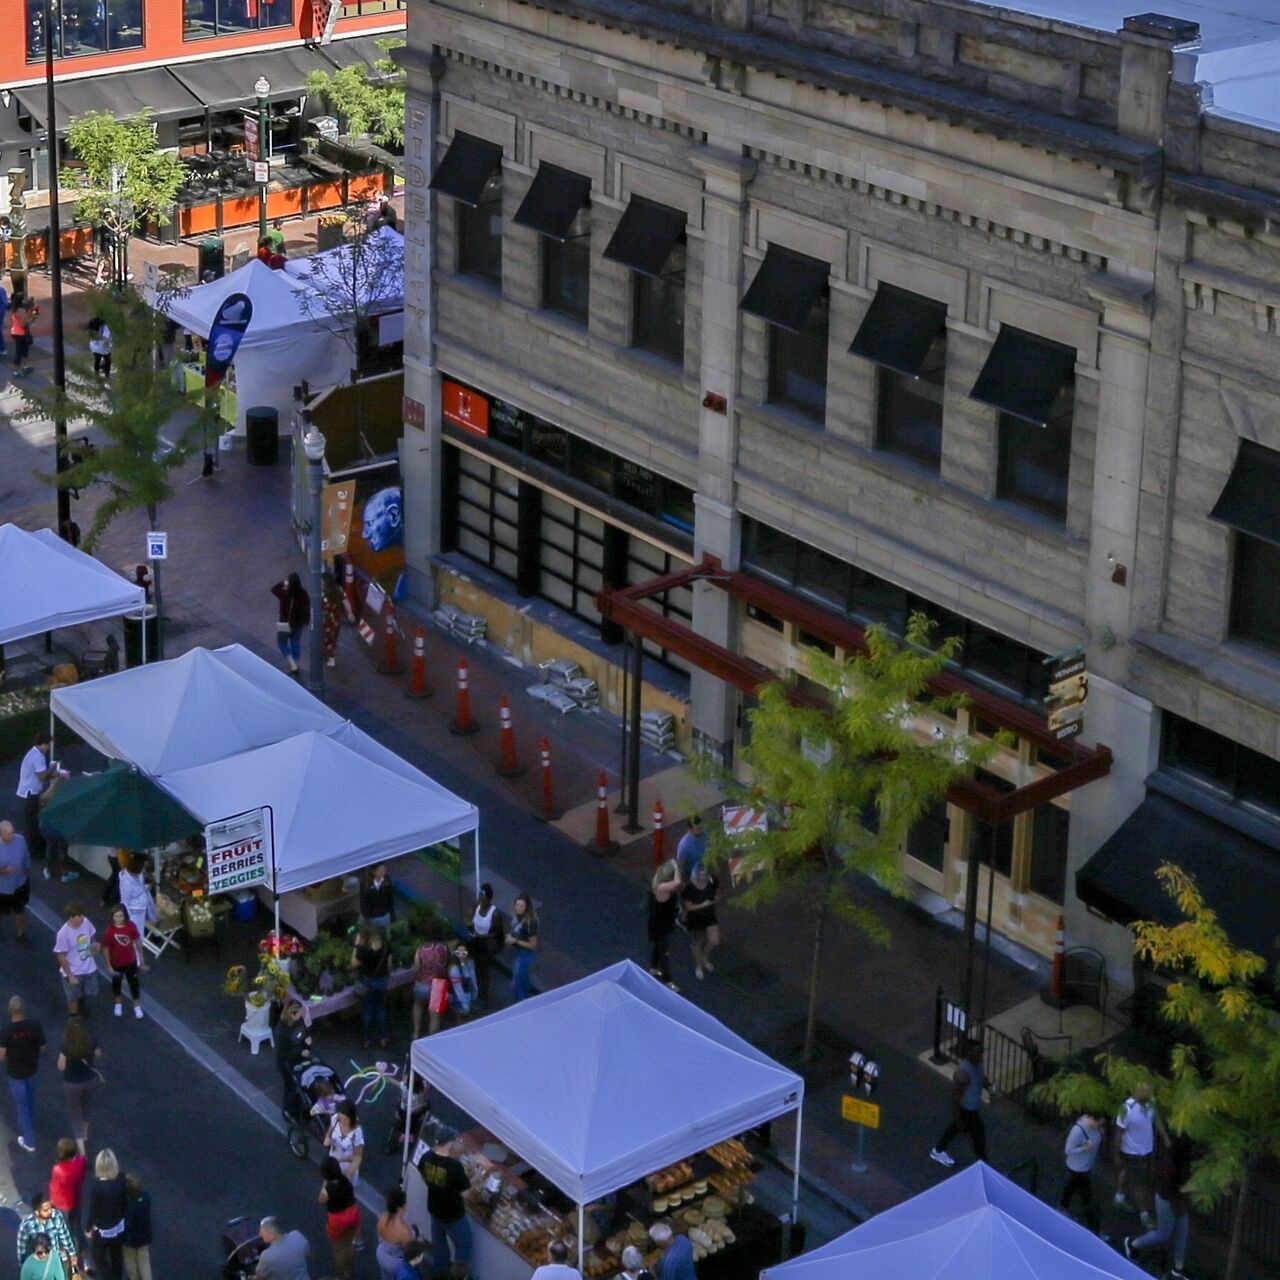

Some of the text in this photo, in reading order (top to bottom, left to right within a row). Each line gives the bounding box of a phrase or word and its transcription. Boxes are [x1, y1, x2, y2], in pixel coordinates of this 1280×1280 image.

[211, 839, 263, 864] FRUIT
[212, 853, 264, 877] BERRIES
[212, 867, 265, 890] VEGGIES
